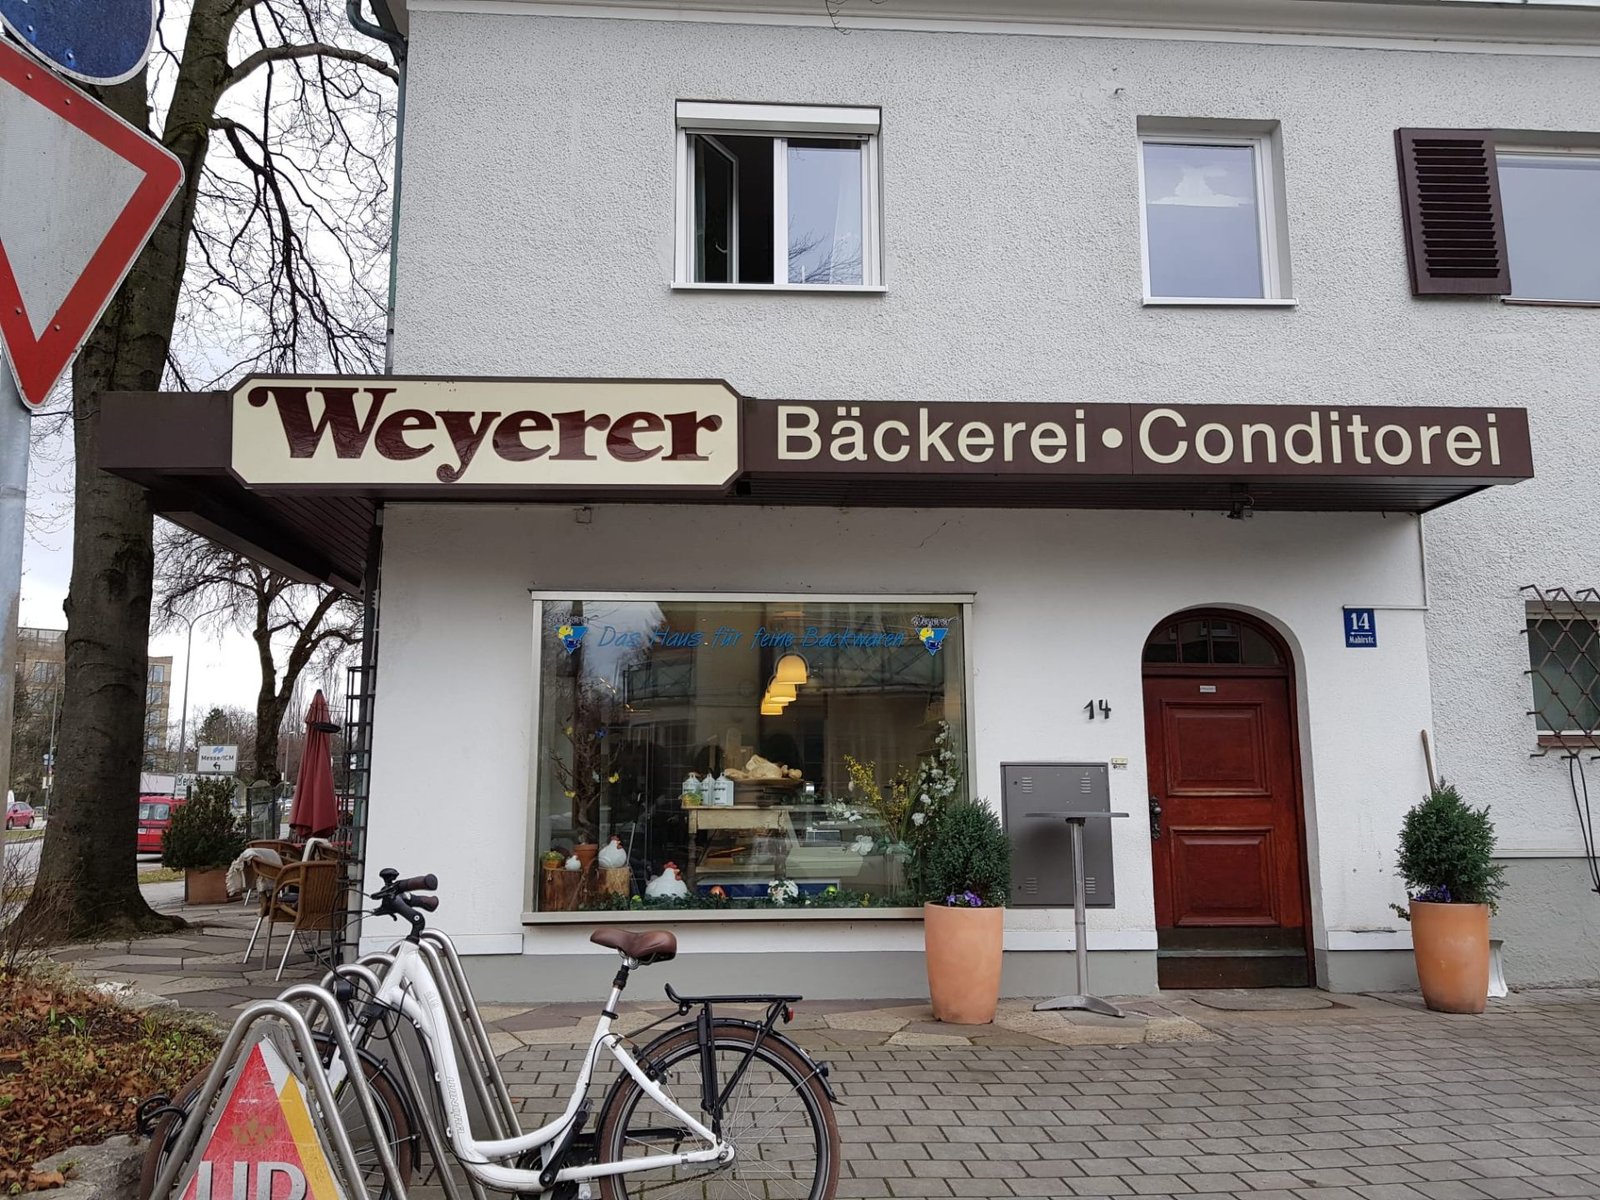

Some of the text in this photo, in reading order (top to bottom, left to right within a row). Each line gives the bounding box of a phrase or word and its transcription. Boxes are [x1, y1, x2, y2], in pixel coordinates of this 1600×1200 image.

[247, 386, 724, 484] Weyerer
[777, 405, 1502, 467] Bäckerei Conditorei
[1350, 612, 1370, 630] 14
[598, 625, 907, 649] Das Haus für feine Backwaren
[1083, 699, 1112, 720] 14
